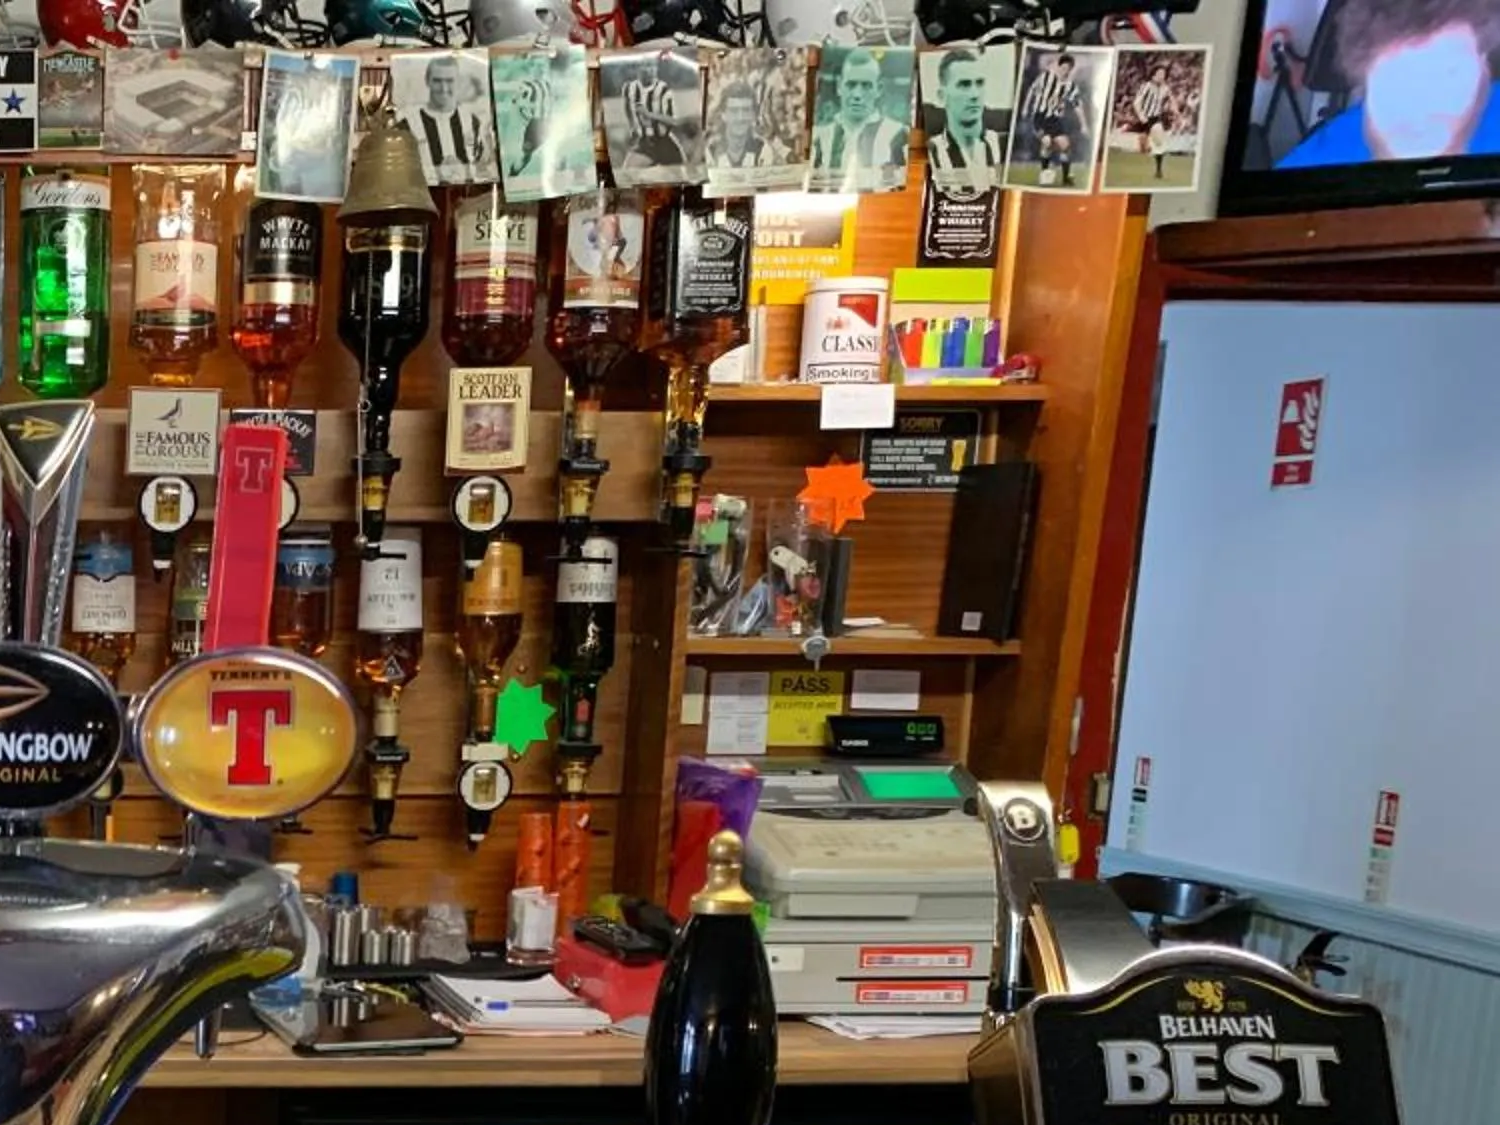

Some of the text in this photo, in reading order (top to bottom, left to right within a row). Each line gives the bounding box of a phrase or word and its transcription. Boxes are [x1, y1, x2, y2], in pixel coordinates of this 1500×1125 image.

[938, 216, 985, 227] WHISKEY
[458, 385, 523, 400] LEADER
[146, 431, 211, 447] FAMOUS
[145, 445, 211, 458] GROUSE
[780, 675, 832, 694] PASS
[208, 688, 295, 788] T
[1159, 1014, 1276, 1041] BELHAVEN
[1097, 1039, 1341, 1107] BEST
